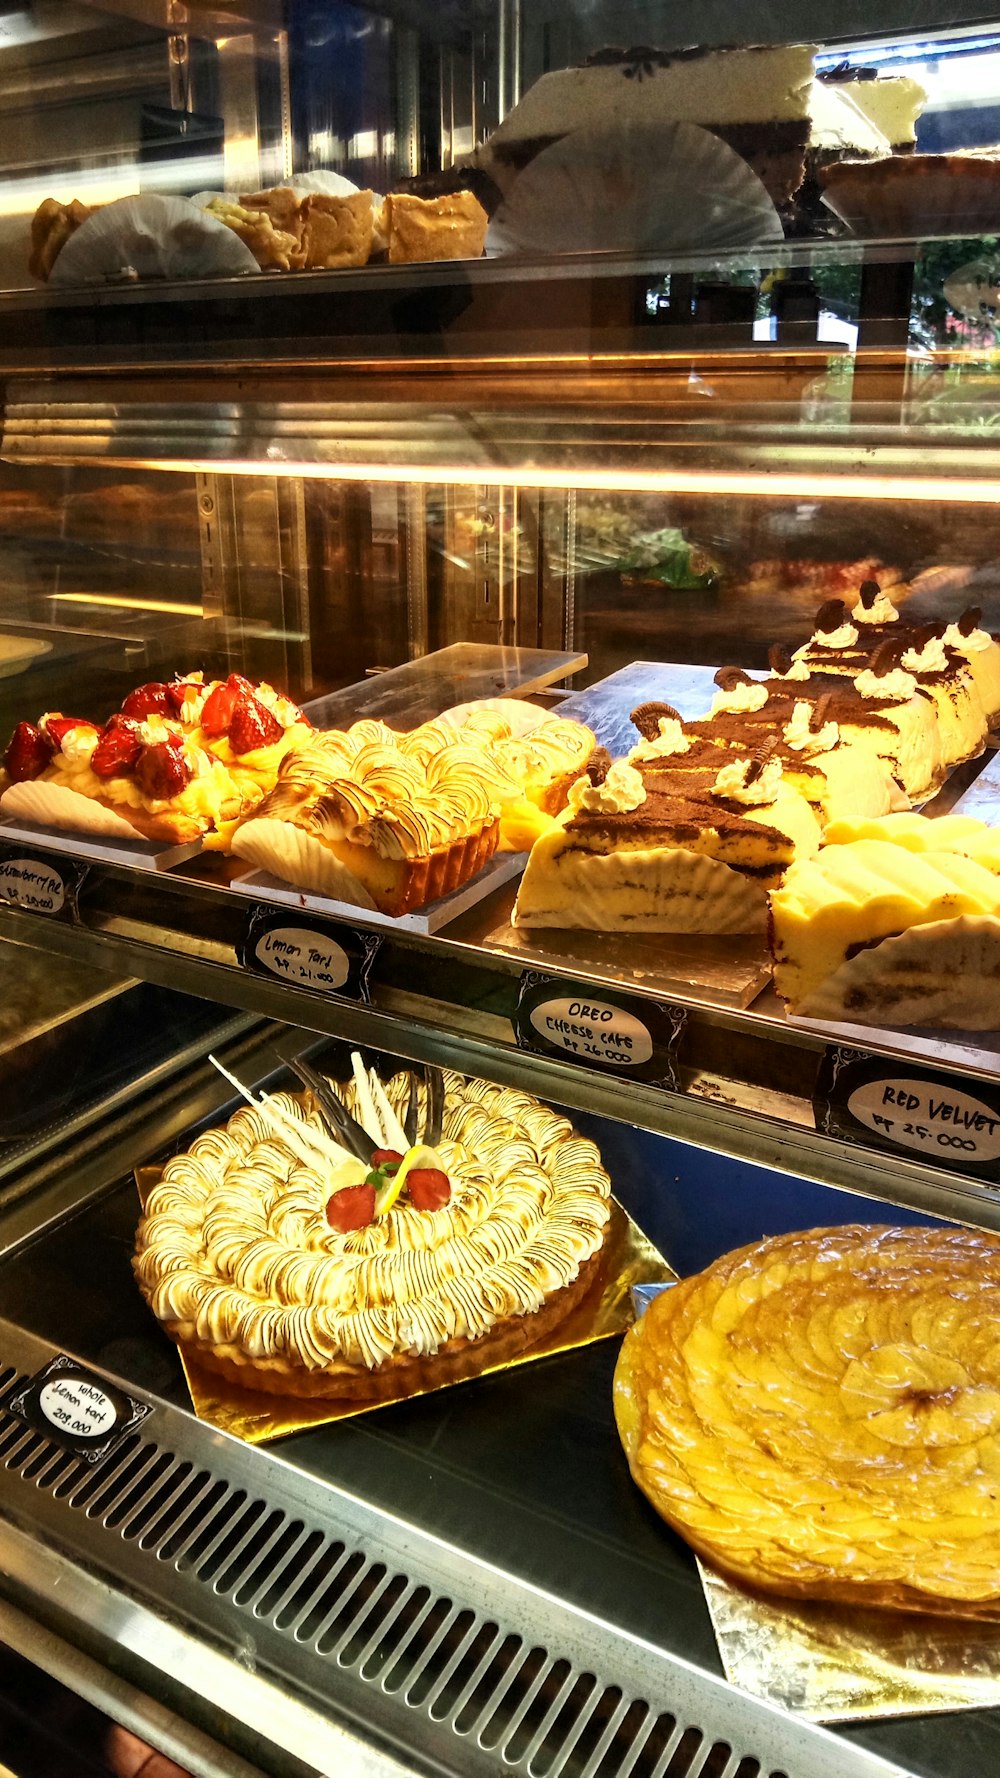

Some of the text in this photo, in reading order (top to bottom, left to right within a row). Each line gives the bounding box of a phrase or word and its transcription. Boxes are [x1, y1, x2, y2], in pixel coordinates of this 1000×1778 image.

[265, 935, 332, 969] Lemon Tart
[568, 1002, 613, 1022] OREO
[545, 1016, 633, 1049] CHEESE CAKE
[583, 1042, 632, 1063] 26.000
[882, 1086, 1000, 1136] RED VELVET
[903, 1122, 977, 1152] 25.000
[85, 1405, 107, 1424] tart
